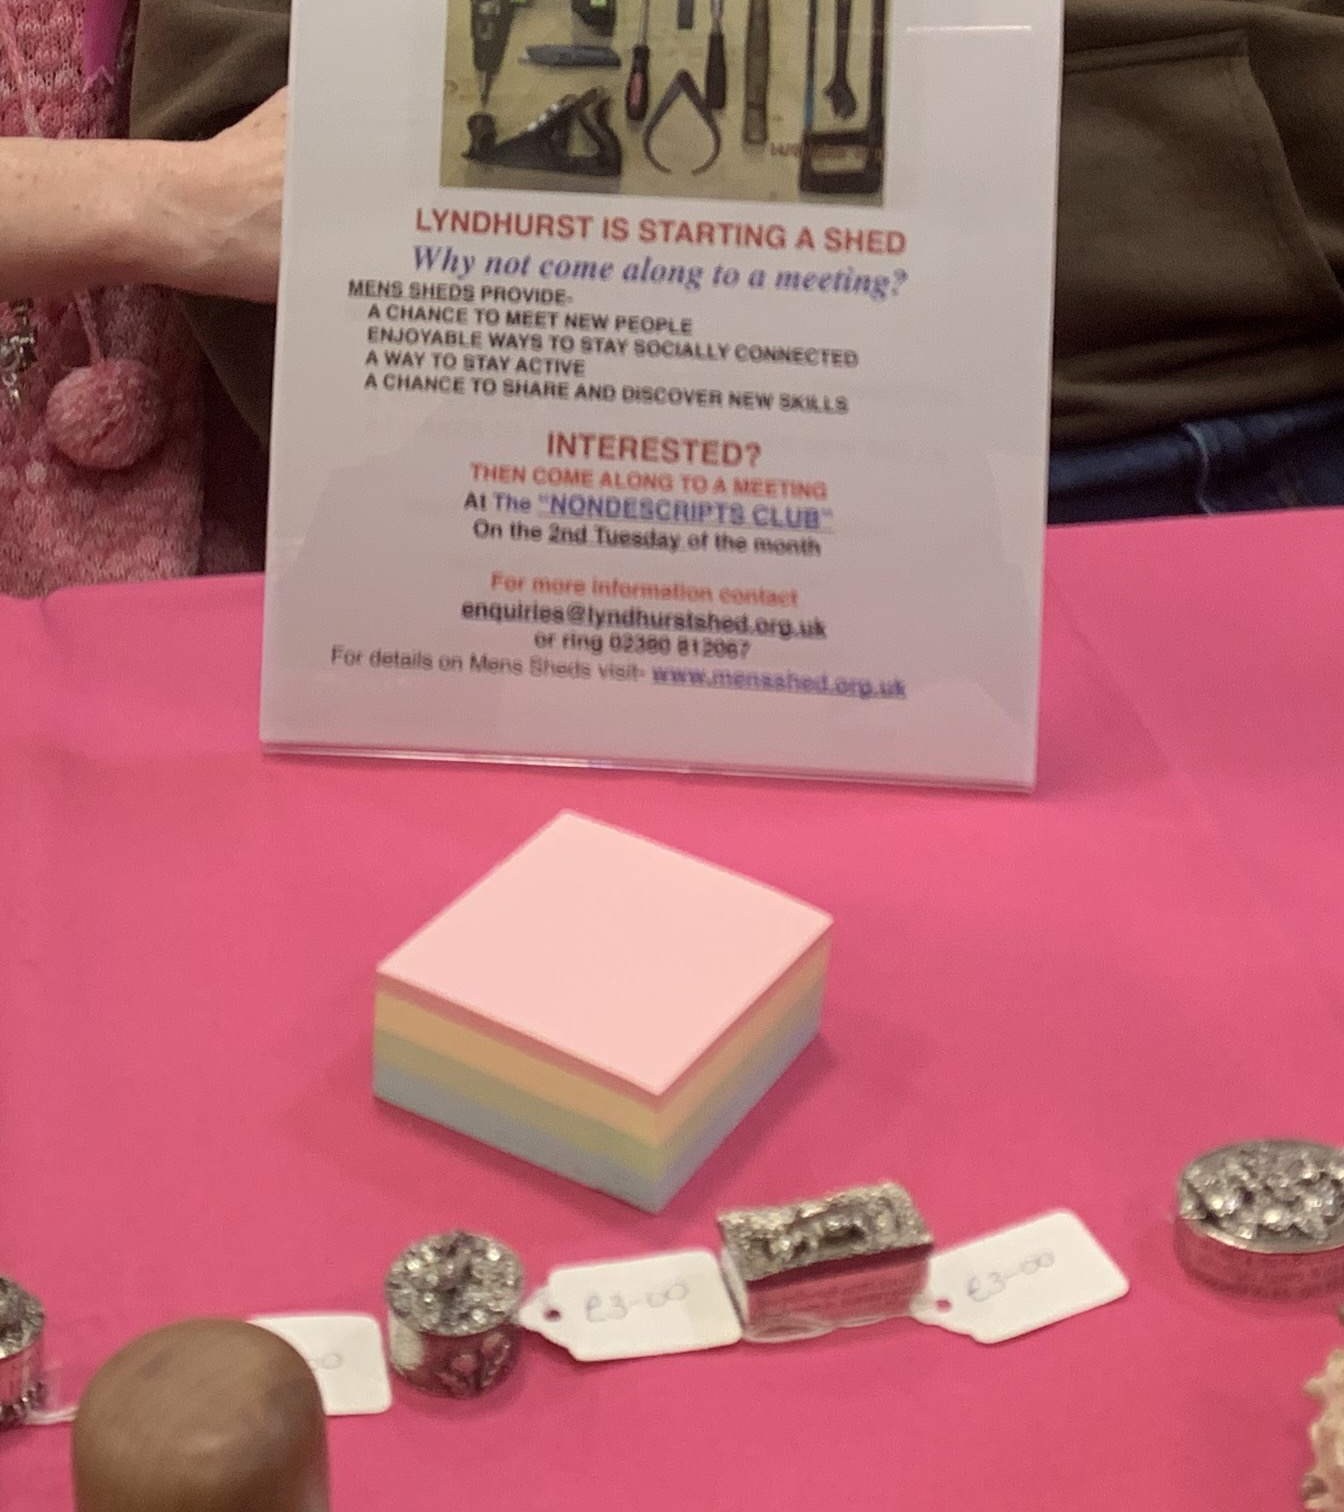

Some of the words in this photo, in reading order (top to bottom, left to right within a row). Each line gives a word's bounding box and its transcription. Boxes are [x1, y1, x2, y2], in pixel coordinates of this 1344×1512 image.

[415, 207, 594, 240] LYNDHURST
[602, 216, 630, 243] IS
[638, 217, 787, 250] STARTING
[794, 225, 816, 251] A
[823, 226, 907, 256] SHED
[347, 279, 403, 299] MENS
[409, 281, 476, 303] SHEDS
[413, 244, 475, 280] Why
[484, 254, 532, 277] not
[538, 256, 614, 281] come
[621, 255, 704, 293] along
[712, 263, 740, 287] to
[747, 266, 767, 290] a
[774, 265, 909, 303] meeting?
[367, 303, 382, 321] A
[386, 304, 469, 326] CHANCE
[474, 307, 501, 327] TO
[506, 309, 558, 330] MEET
[564, 312, 609, 332] NEW
[614, 314, 694, 336] PEOPLE
[364, 349, 379, 368] A
[384, 349, 426, 370] WAY
[432, 351, 458, 372] TO
[462, 353, 511, 375] STAY
[515, 355, 586, 378] ACTIVE
[367, 325, 483, 349] ENJOYABLE
[489, 332, 543, 352] WAYS
[551, 334, 575, 354] TO
[580, 336, 629, 357] STAY
[633, 338, 729, 362] SOCIALLY
[734, 342, 860, 369] CONNECTED
[363, 372, 378, 391] A
[382, 373, 466, 396] CHANCE
[471, 376, 498, 397] TO
[502, 377, 570, 400] SHARE
[574, 381, 617, 403] AND
[728, 390, 775, 411] NEW
[778, 393, 851, 416] SKILLS
[546, 429, 762, 470] INTERESTED?
[463, 489, 488, 512] At
[493, 490, 532, 514] The
[470, 461, 527, 485] THEN
[532, 465, 594, 488] COME
[598, 469, 674, 493] ALONG
[680, 472, 708, 495] TO
[712, 475, 728, 495] A
[733, 477, 829, 502] MEETING
[472, 517, 504, 540] On
[509, 519, 543, 541] the
[547, 521, 588, 546] 2nd
[593, 523, 679, 554] Tuesday
[686, 530, 709, 551] of
[713, 532, 748, 554] the
[752, 535, 823, 559] month
[490, 569, 525, 592] For
[531, 575, 587, 597] more
[592, 577, 714, 605] information
[718, 585, 800, 609] contact
[460, 599, 828, 642] enquiries@lyndhurstshed.org.uk
[533, 631, 555, 649] or
[561, 632, 605, 657] ring
[330, 643, 363, 667] For
[368, 646, 434, 671] details
[438, 652, 464, 673] on
[469, 650, 524, 675] Mens
[528, 654, 593, 681] Sheds
[651, 662, 907, 701] www.mensshed.org.uk
